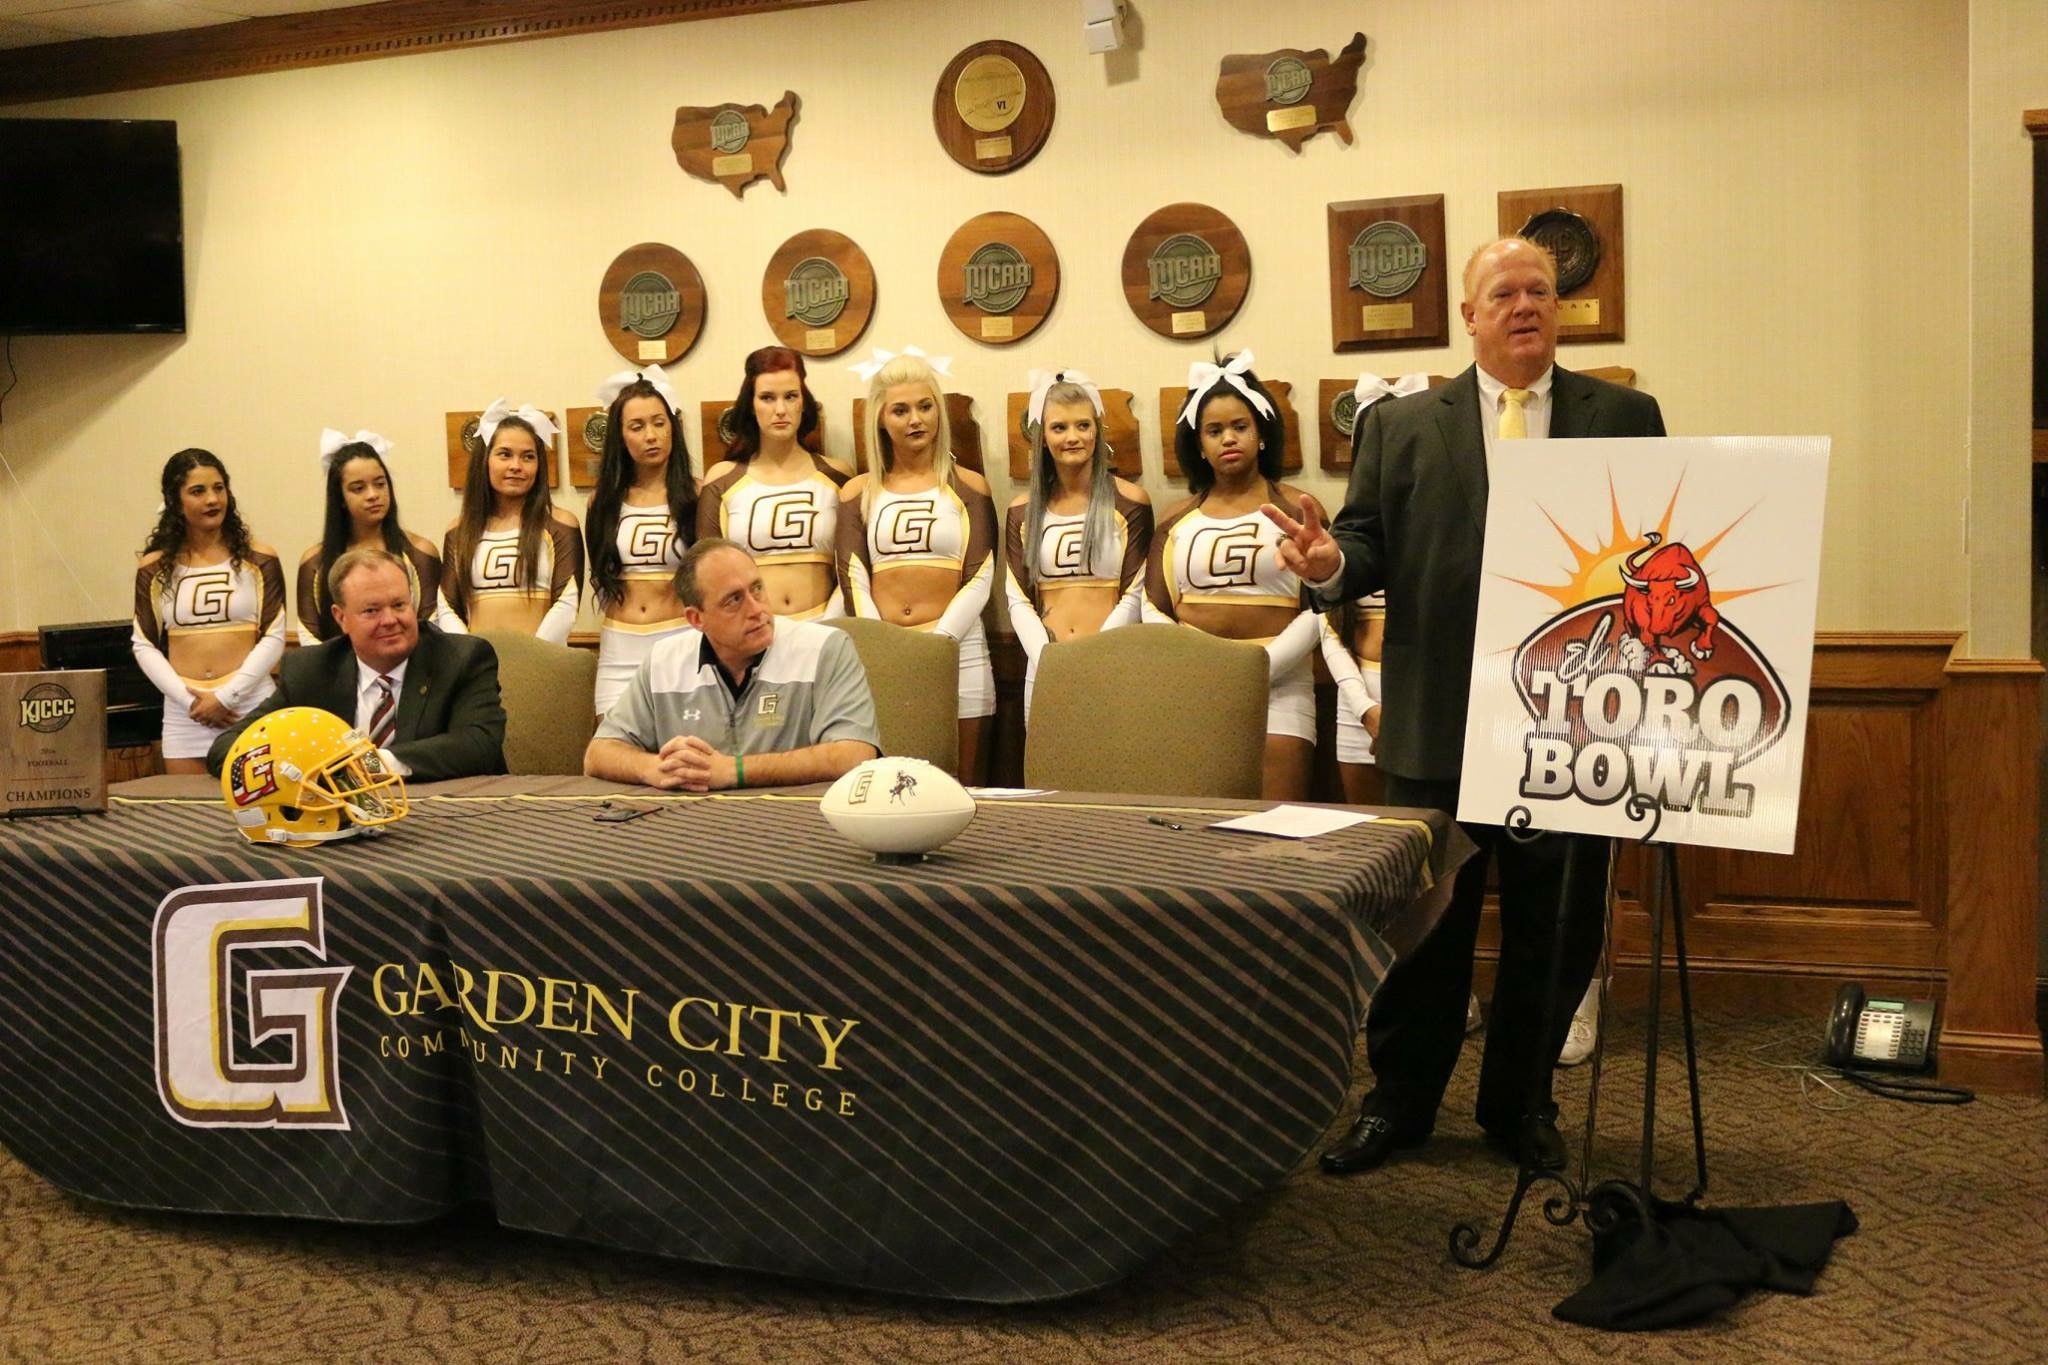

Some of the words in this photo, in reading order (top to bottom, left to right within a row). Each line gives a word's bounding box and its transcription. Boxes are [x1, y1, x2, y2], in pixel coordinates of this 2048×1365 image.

[996, 100, 1007, 110] VI
[963, 262, 1032, 303] NJCAA
[1147, 254, 1221, 299] NJCAA
[1348, 243, 1425, 287] NJCAA
[620, 290, 680, 328] NJCAA
[784, 277, 849, 318] NJCAA
[21, 698, 75, 726] KJCCC
[1531, 670, 1763, 749] TORO
[6, 788, 91, 802] CHAMPIONS
[1522, 737, 1754, 816] BOWL
[373, 960, 640, 1041] GARDEN
[669, 997, 860, 1070] CITY
[647, 1064, 856, 1116] COLLEGE
